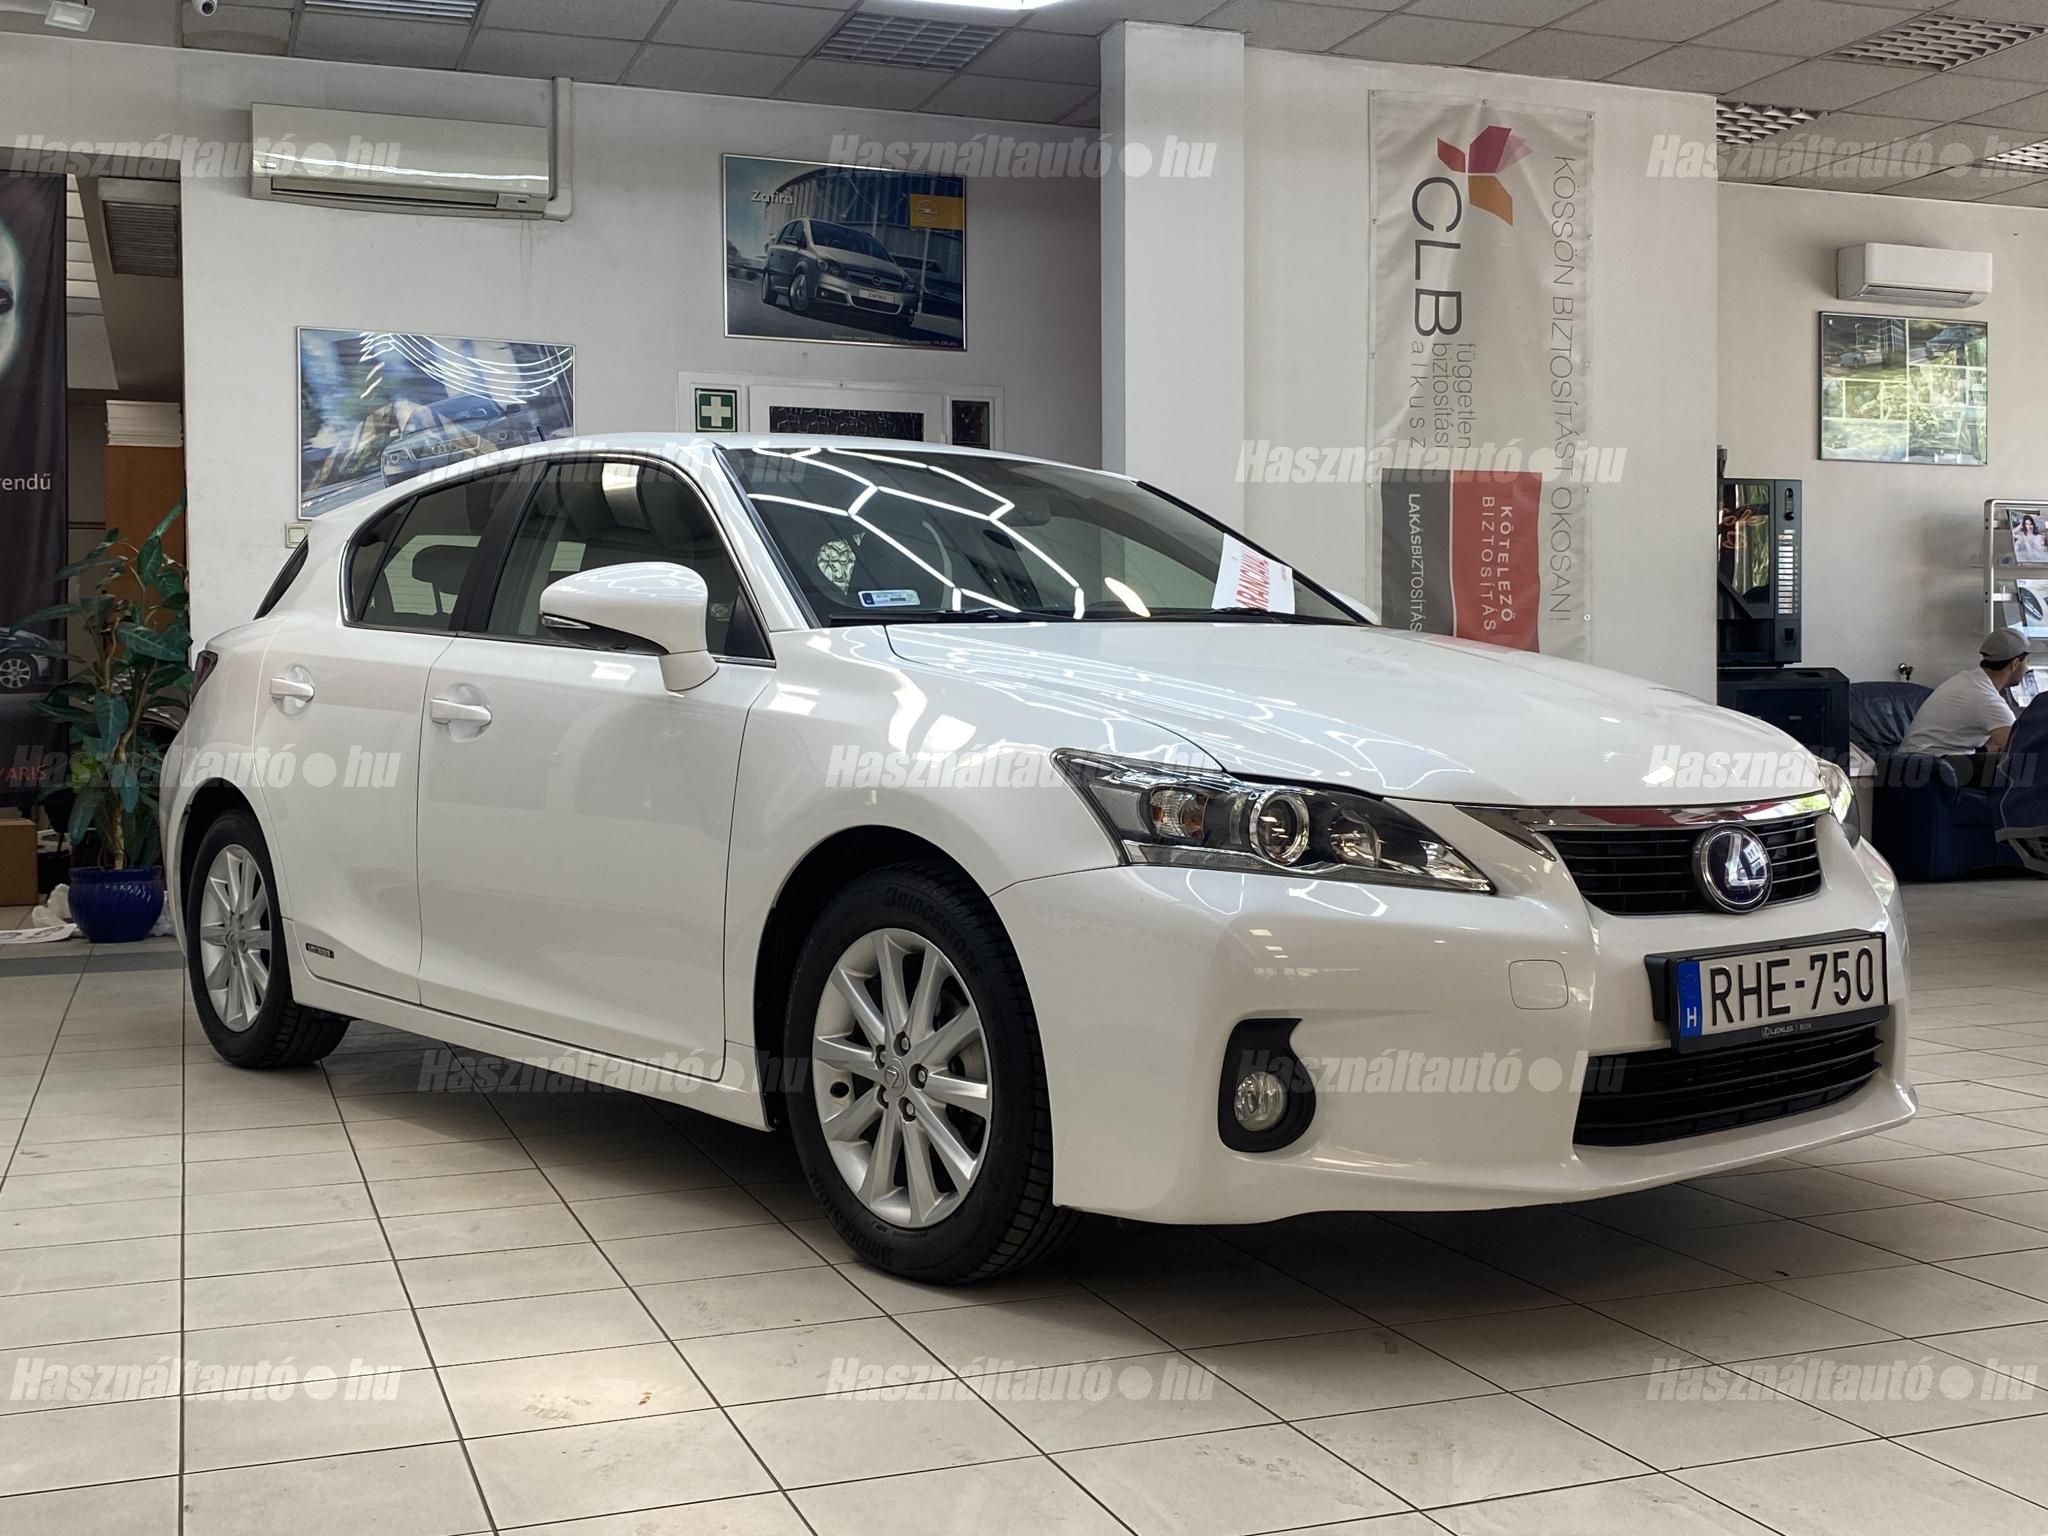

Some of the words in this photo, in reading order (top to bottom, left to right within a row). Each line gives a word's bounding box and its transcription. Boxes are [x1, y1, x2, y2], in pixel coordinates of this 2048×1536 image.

[1411, 176, 1462, 337] CLB
[1551, 155, 1580, 286] KÖSSÖN
[1408, 340, 1428, 449] alkusz
[1431, 342, 1455, 449] biztosítási
[1452, 342, 1477, 449] független
[1549, 296, 1580, 473] BIZTOSÍTÁST
[0, 472, 51, 491] endű
[1480, 496, 1496, 631] BIZTOSÍTÁS
[1549, 486, 1572, 622] OKOSAN!
[1686, 1006, 1697, 1029] H
[1709, 945, 1875, 1027] RHE-750
